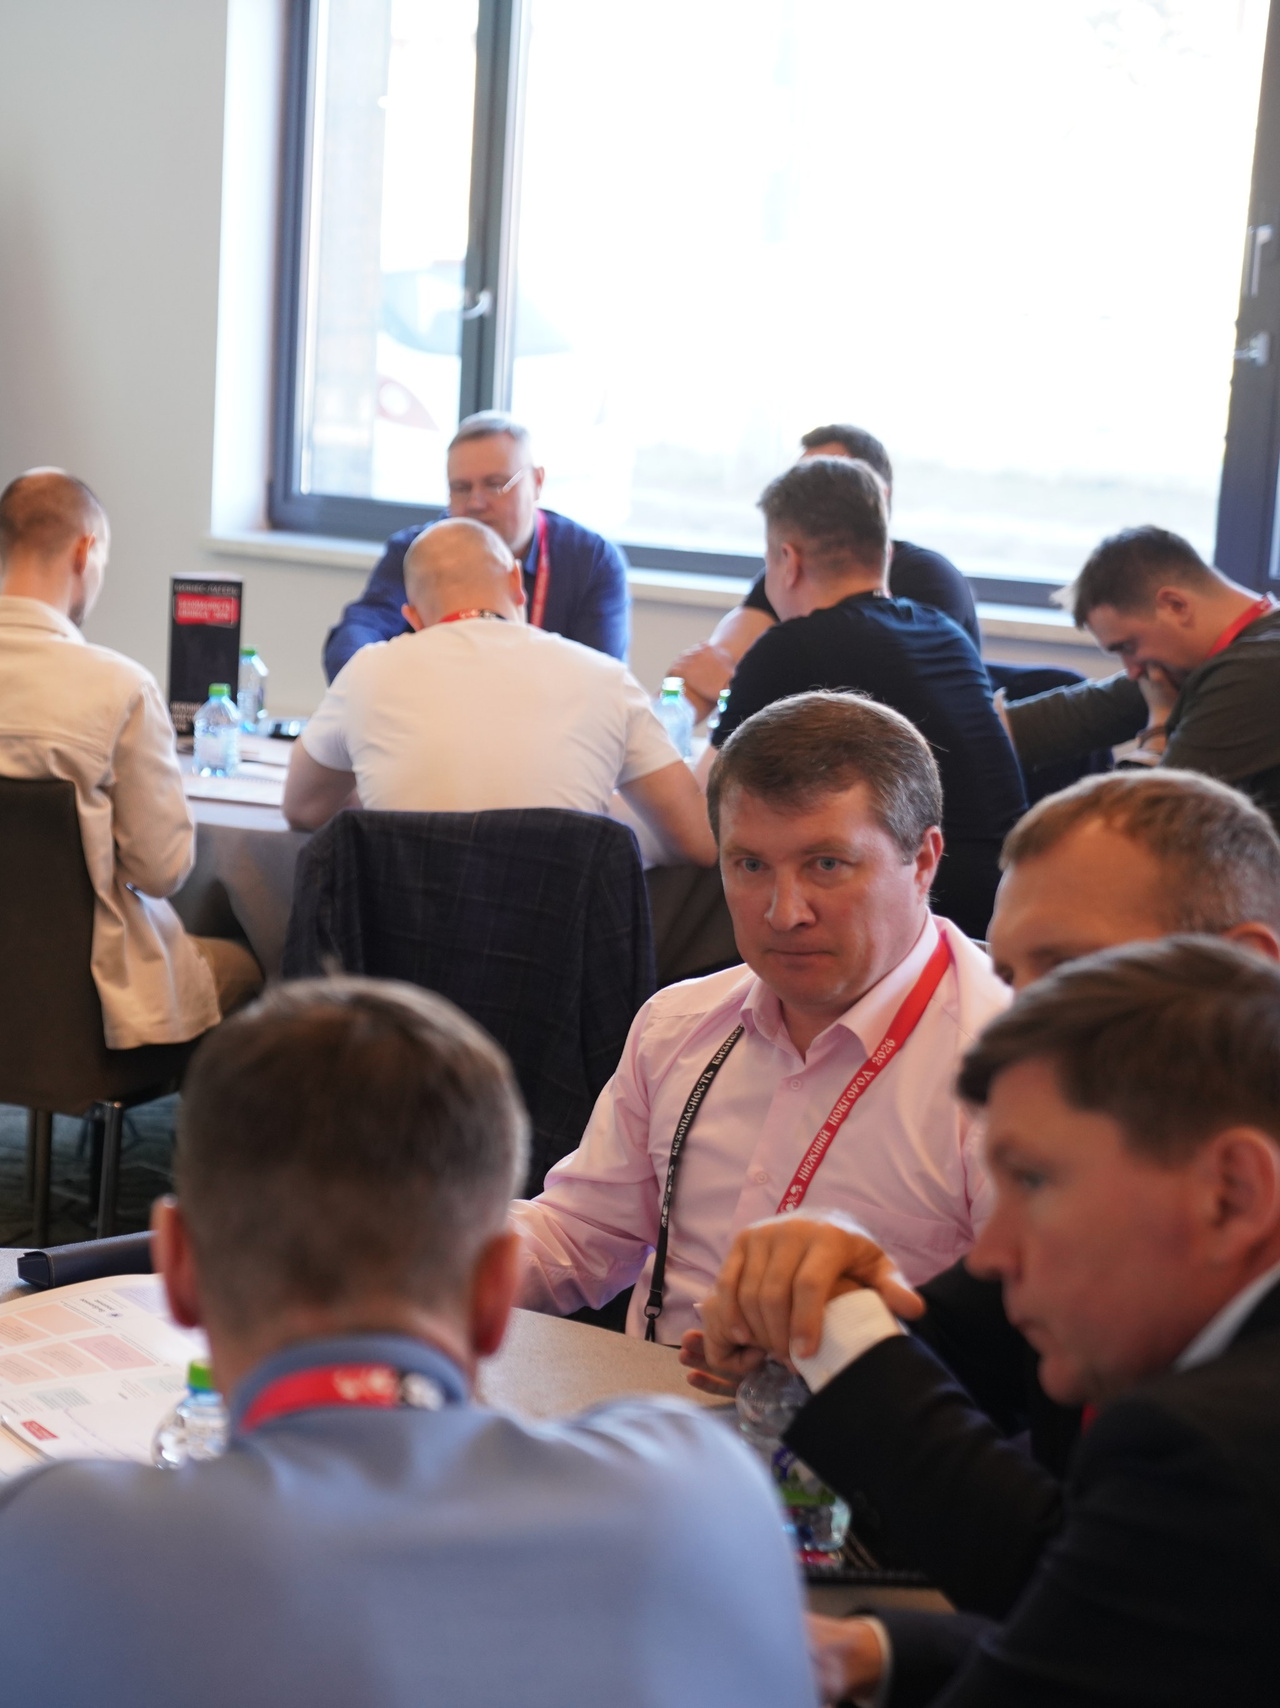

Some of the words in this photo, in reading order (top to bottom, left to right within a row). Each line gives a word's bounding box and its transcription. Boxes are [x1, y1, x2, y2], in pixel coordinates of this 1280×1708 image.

[671, 1070, 714, 1156] БЕЗОПАСНОСТЬ
[799, 1129, 831, 1181] НИЖНИЙ
[828, 1070, 874, 1127] НОВГОРОД
[871, 1037, 897, 1067] 2026
